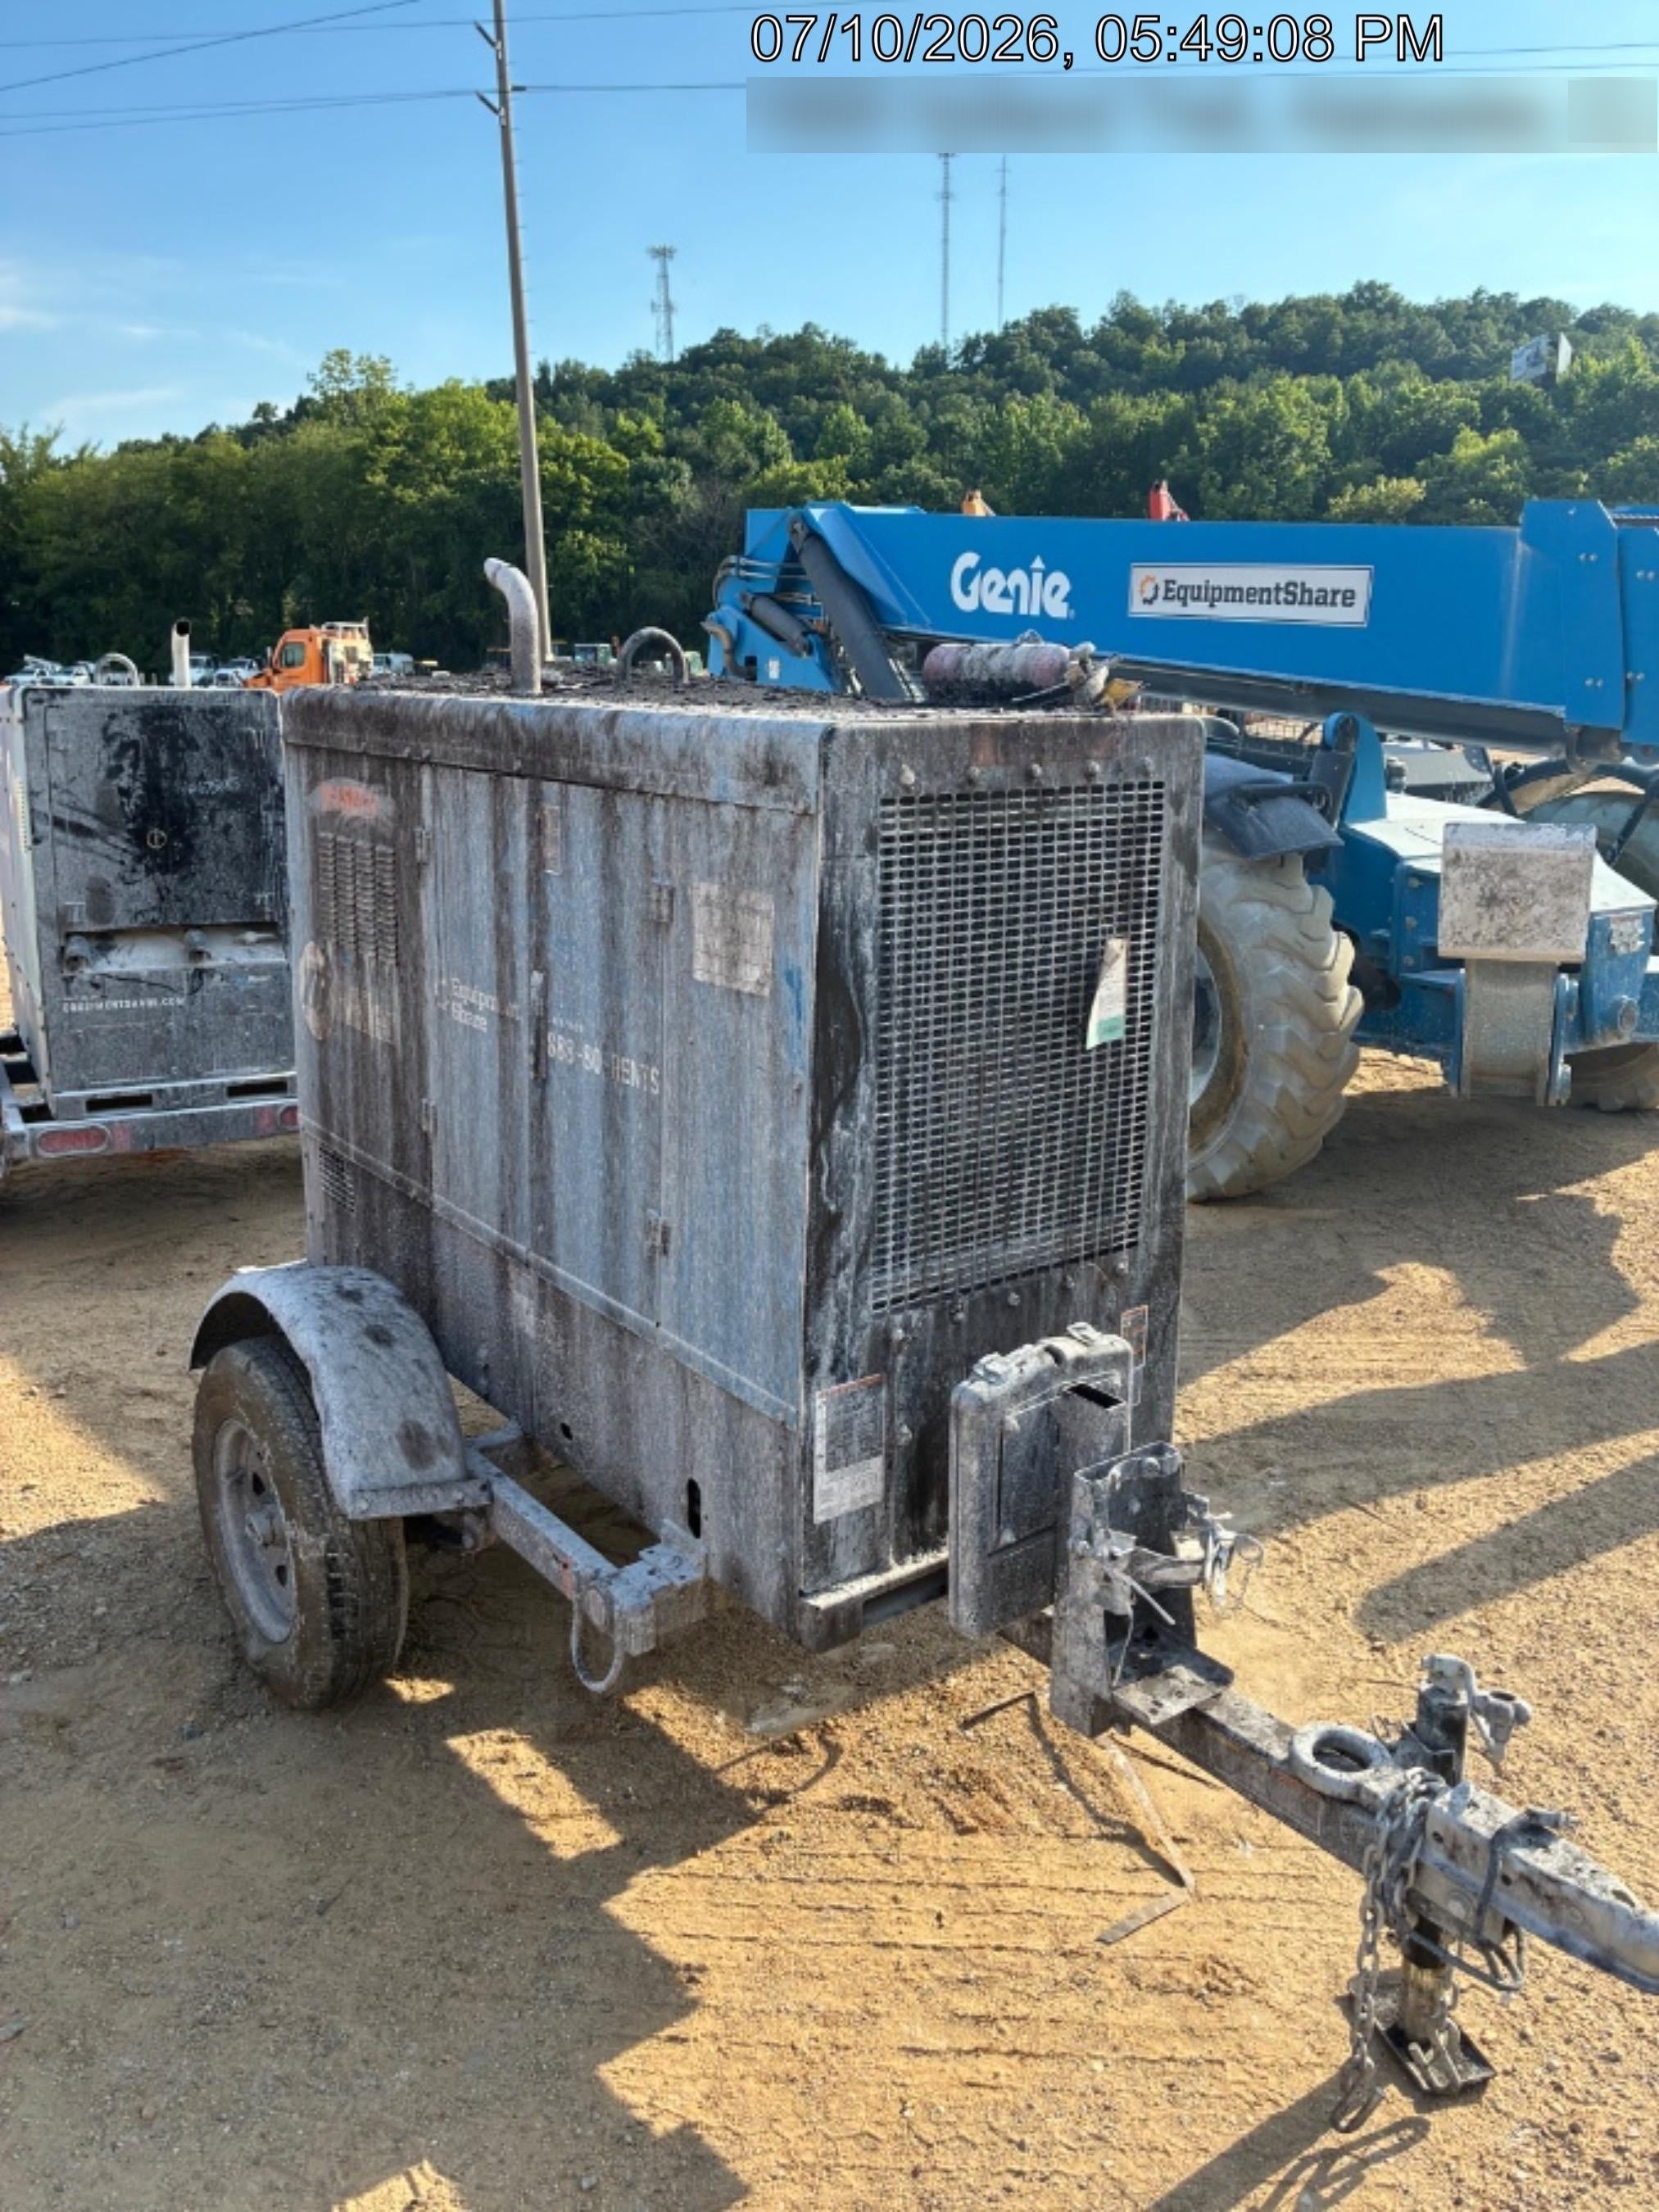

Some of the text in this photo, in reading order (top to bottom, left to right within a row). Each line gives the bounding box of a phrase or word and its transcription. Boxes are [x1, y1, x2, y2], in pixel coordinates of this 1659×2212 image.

[950, 550, 1072, 619] Genie
[1161, 578, 1357, 609] EquipmentShare
[451, 977, 522, 1022] Equipmnt
